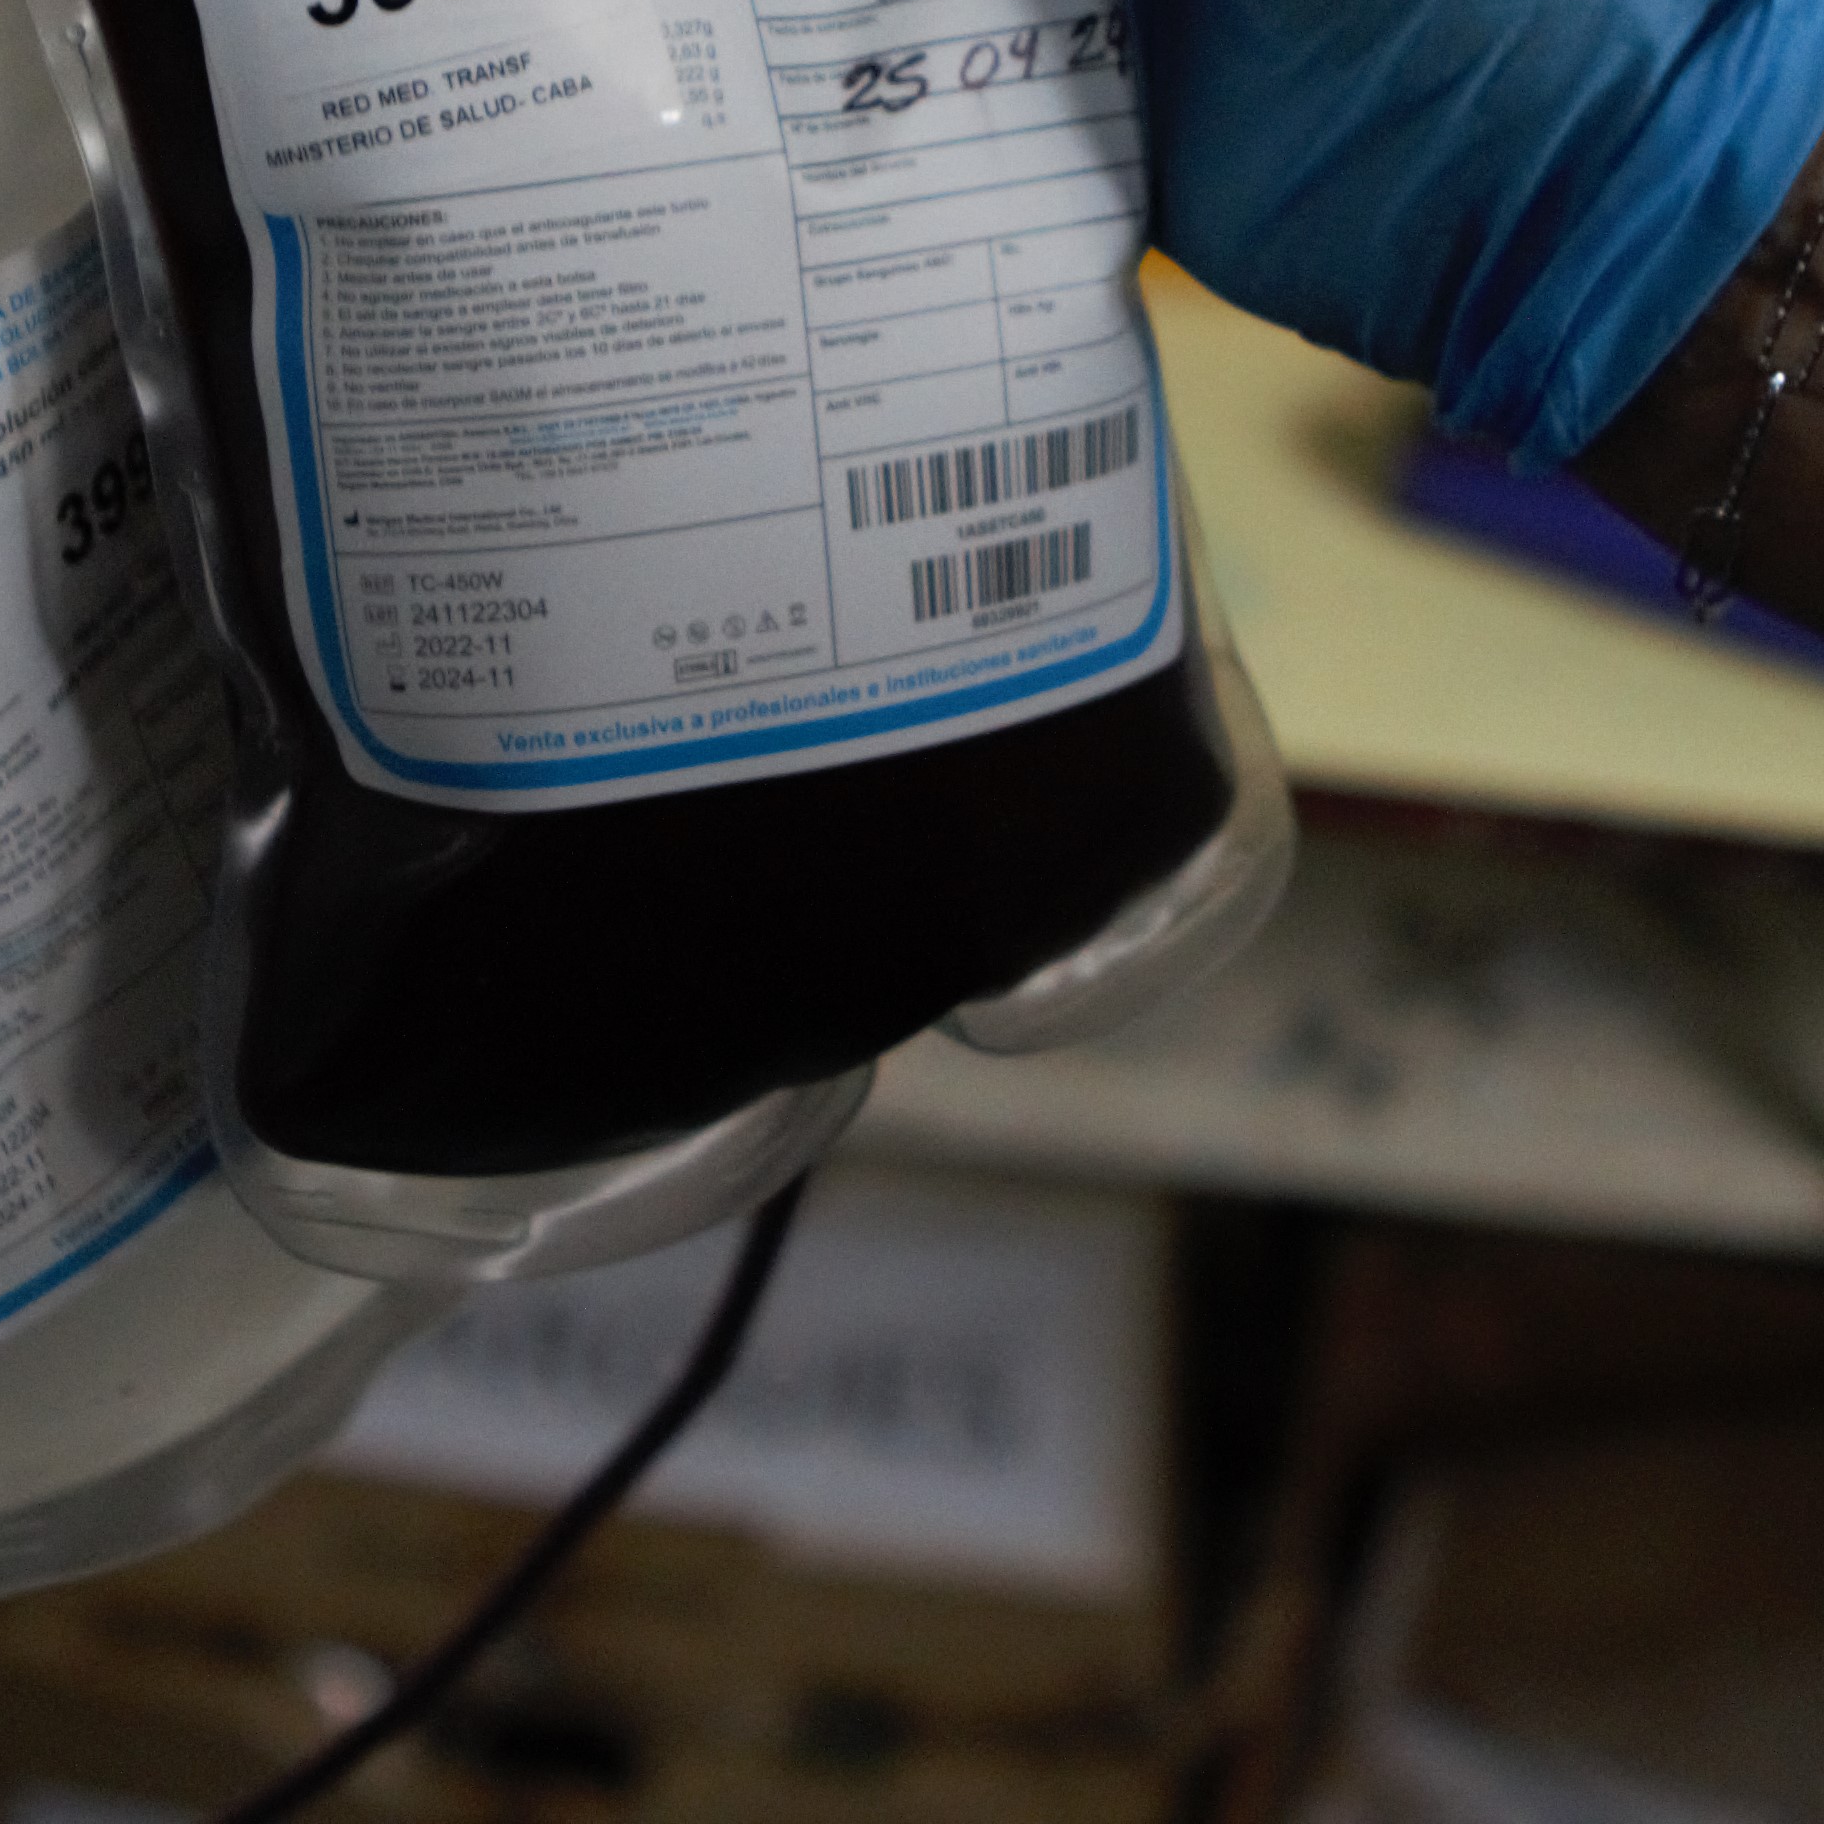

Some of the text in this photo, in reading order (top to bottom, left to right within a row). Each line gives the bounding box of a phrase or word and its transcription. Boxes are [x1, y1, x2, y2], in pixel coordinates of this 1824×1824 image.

[322, 98, 371, 121] RED
[442, 51, 532, 90] TRANSF
[842, 50, 929, 113] 25
[960, 25, 1038, 90] 04
[266, 125, 393, 167] MINISTERIO
[401, 115, 433, 140] DE
[533, 75, 594, 106] CABA
[407, 572, 504, 593] TC-450W
[412, 597, 548, 625] 241122304
[414, 634, 513, 658] 2022-11
[418, 667, 515, 690] 2024-11
[497, 731, 565, 754] Venta
[575, 714, 682, 747] exclusiva
[691, 713, 703, 728] a
[711, 685, 861, 730] profesionales
[886, 650, 1013, 697] instituciones
[1016, 626, 1099, 665] sanitarias
